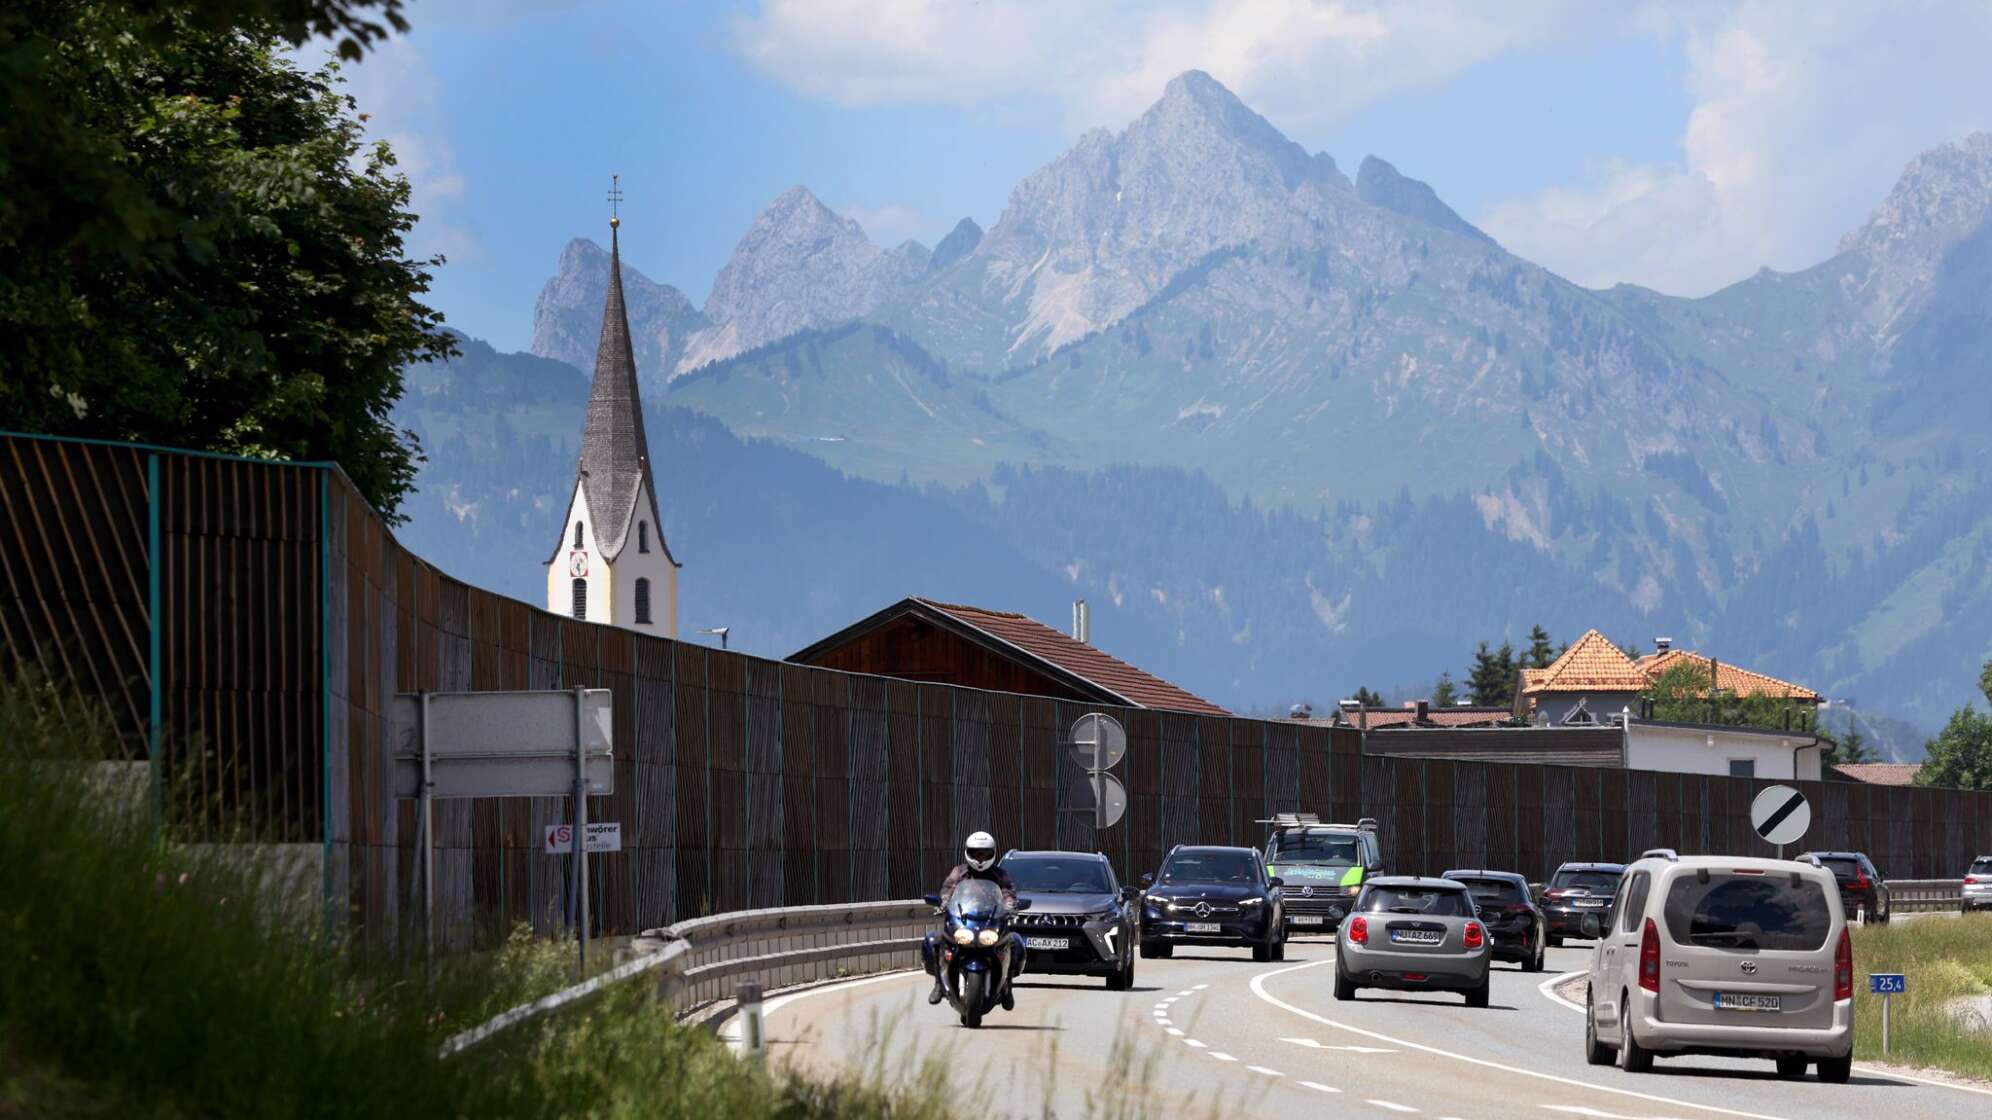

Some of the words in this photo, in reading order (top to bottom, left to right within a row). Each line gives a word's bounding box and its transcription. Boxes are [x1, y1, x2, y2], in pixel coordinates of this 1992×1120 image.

[1879, 977, 1902, 992] 25,4
[1721, 994, 1735, 1006] MN
[1742, 995, 1756, 1007] CF
[1759, 996, 1778, 1008] 520
